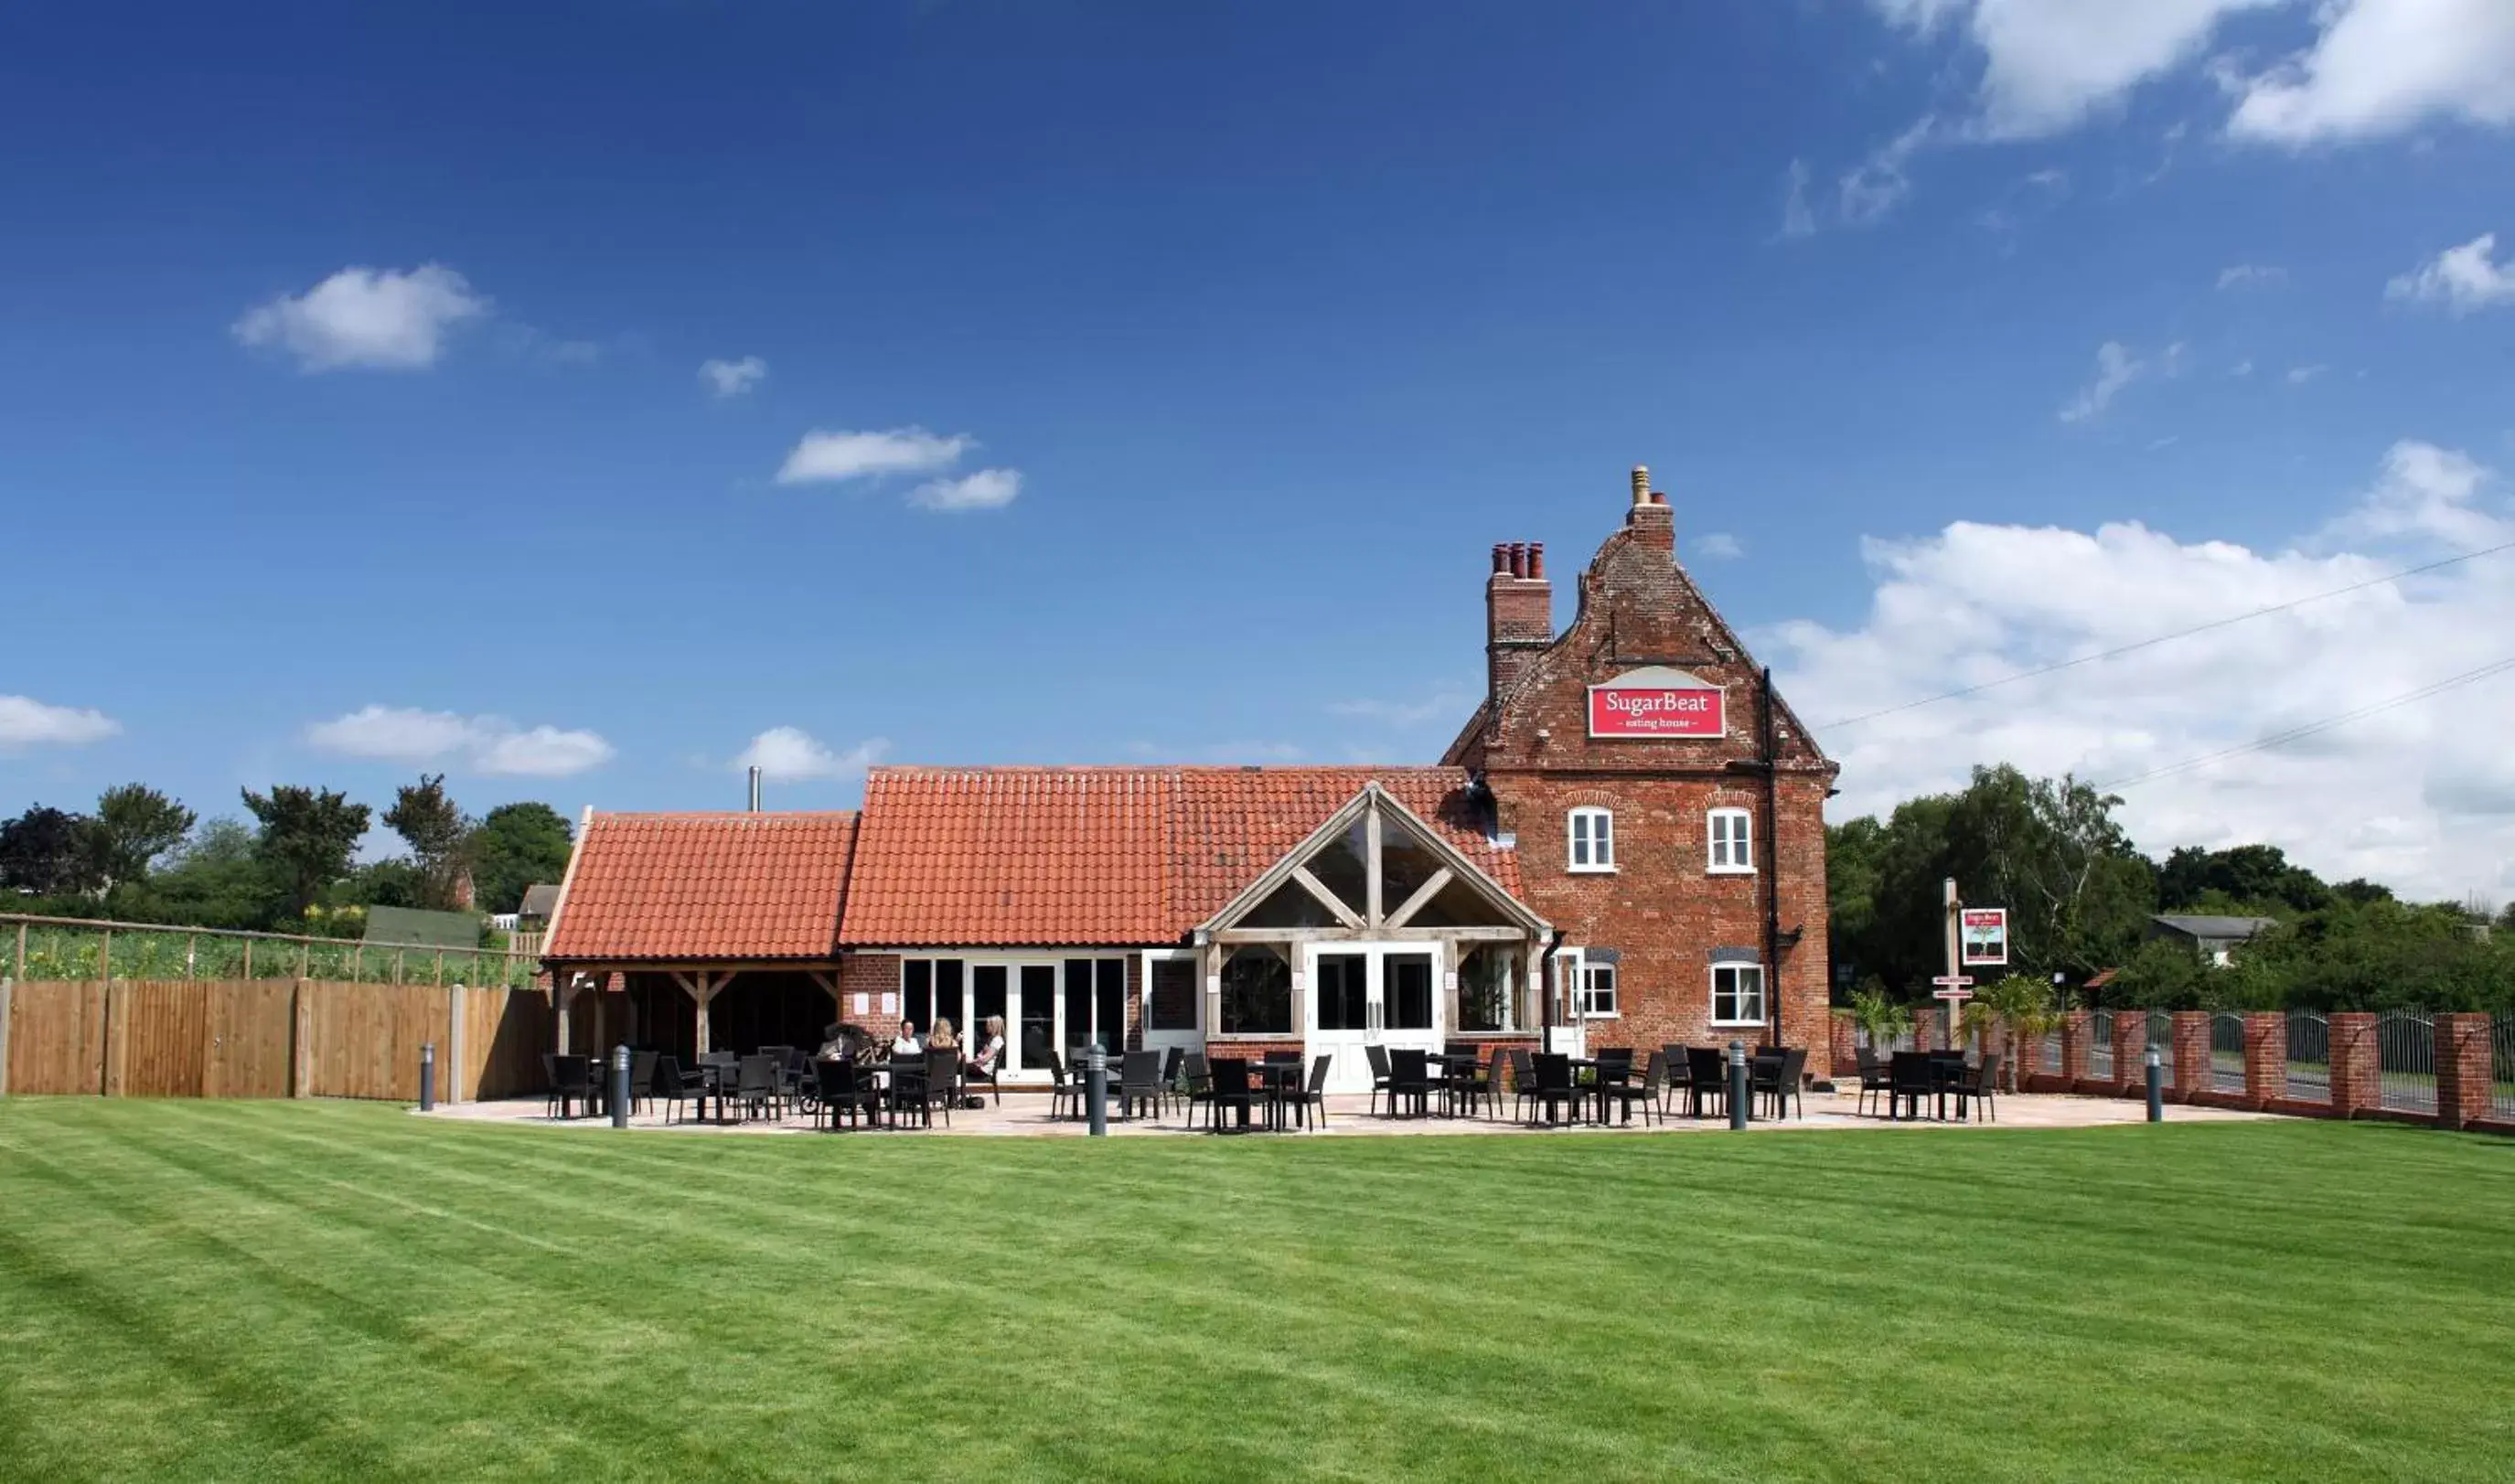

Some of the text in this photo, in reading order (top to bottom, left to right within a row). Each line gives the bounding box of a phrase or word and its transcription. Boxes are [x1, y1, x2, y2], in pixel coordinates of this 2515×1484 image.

[1606, 692, 1708, 716] SugarBeat
[1625, 717, 1689, 730] eating house
